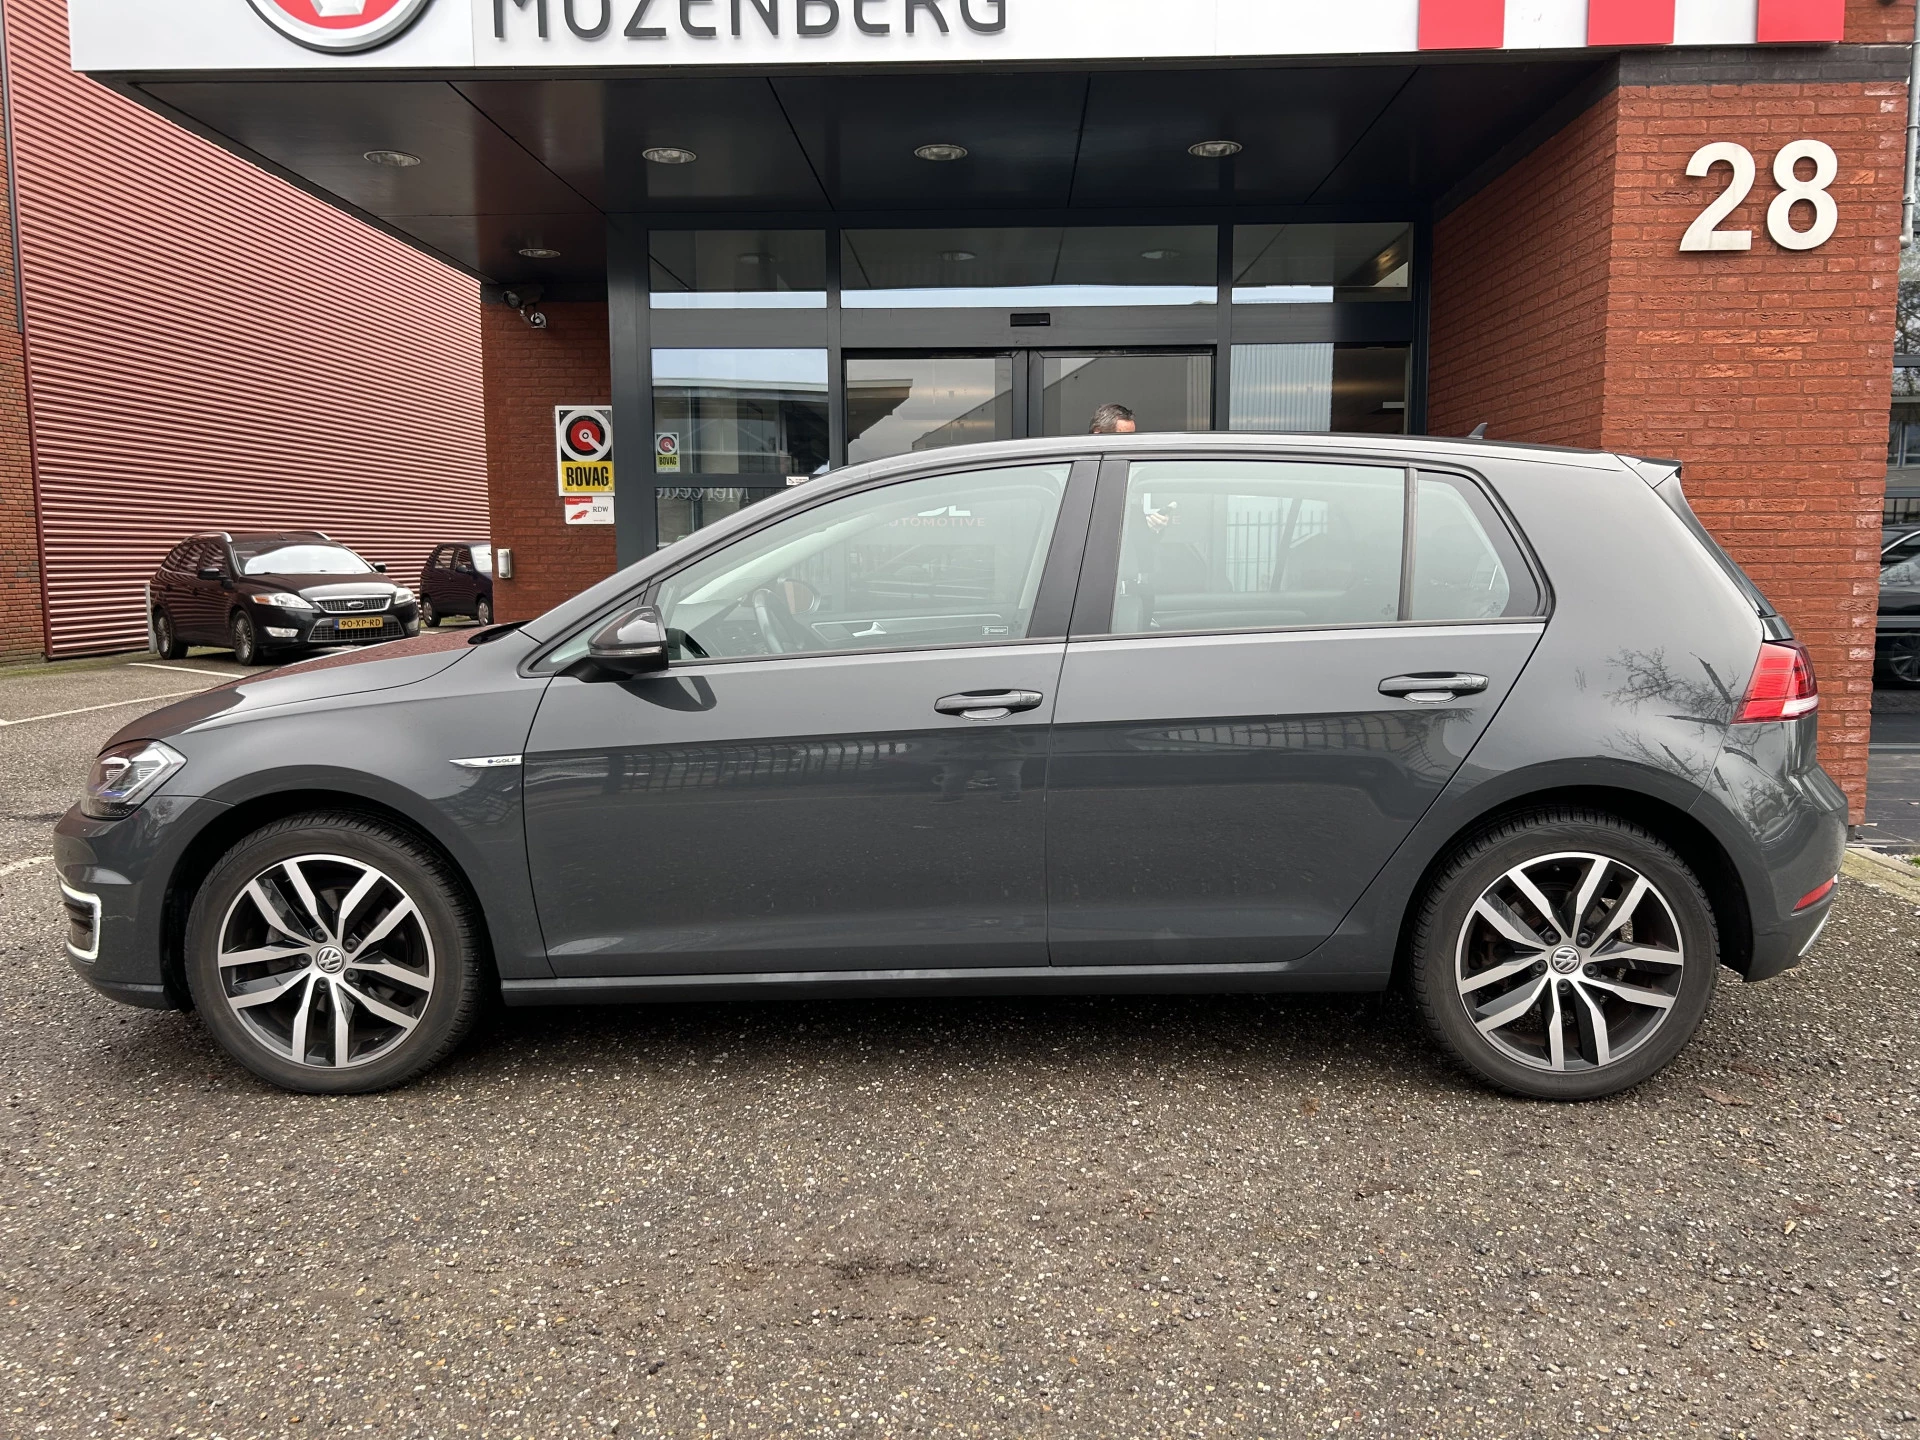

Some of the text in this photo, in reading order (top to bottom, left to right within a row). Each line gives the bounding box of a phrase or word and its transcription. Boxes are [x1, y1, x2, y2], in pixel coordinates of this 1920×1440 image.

[1679, 139, 1838, 251] 28
[659, 456, 677, 466] BOVAG
[566, 466, 609, 487] BOVAG
[887, 517, 986, 527] UTOMOTIVE
[341, 619, 381, 628] 90-XP-RD
